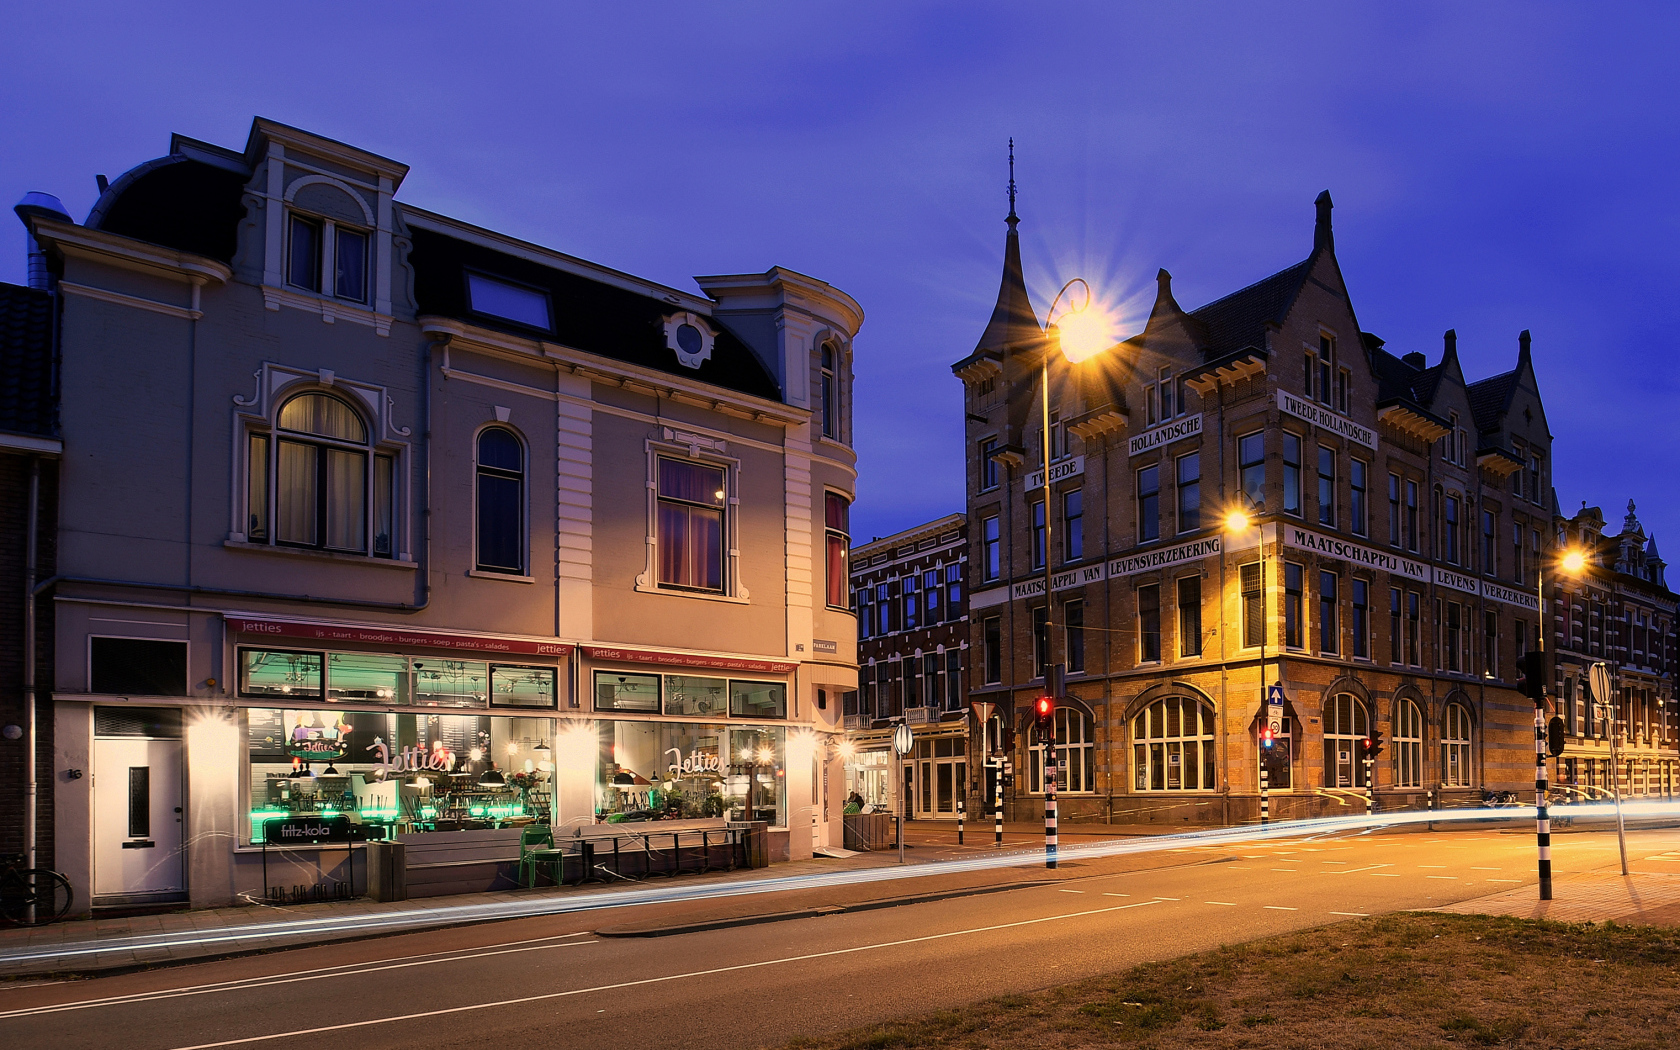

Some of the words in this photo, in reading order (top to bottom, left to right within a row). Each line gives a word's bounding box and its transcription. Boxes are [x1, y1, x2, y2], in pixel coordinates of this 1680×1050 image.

[1130, 416, 1201, 452] HOLLANDSCHE
[1284, 395, 1318, 422] TWEEDE
[1319, 410, 1373, 446] HOLLANDSCHE
[1014, 572, 1077, 598] MAATSCAPPIJ
[1082, 566, 1100, 582] VAN
[1110, 538, 1220, 576] LEVENSVERZEKERING
[1294, 530, 1398, 571] MAATSCHAPPIJ
[1402, 560, 1424, 578] VAN
[1437, 570, 1476, 592] LEVENS
[1484, 583, 1544, 611] VERZEKERIN
[242, 621, 282, 633] jetties
[315, 630, 325, 638] ijs
[332, 631, 352, 639] taart
[359, 632, 393, 642] broodjes
[398, 636, 428, 645] burgers
[433, 639, 451, 647] soep
[484, 642, 510, 651] salades
[536, 643, 567, 654] jetties
[592, 648, 621, 658] jetties
[657, 656, 683, 664] broodjes
[67, 768, 82, 779] 16
[366, 743, 450, 784] Jetties
[664, 747, 725, 783] Jetties
[281, 823, 330, 838] fritz-kola
